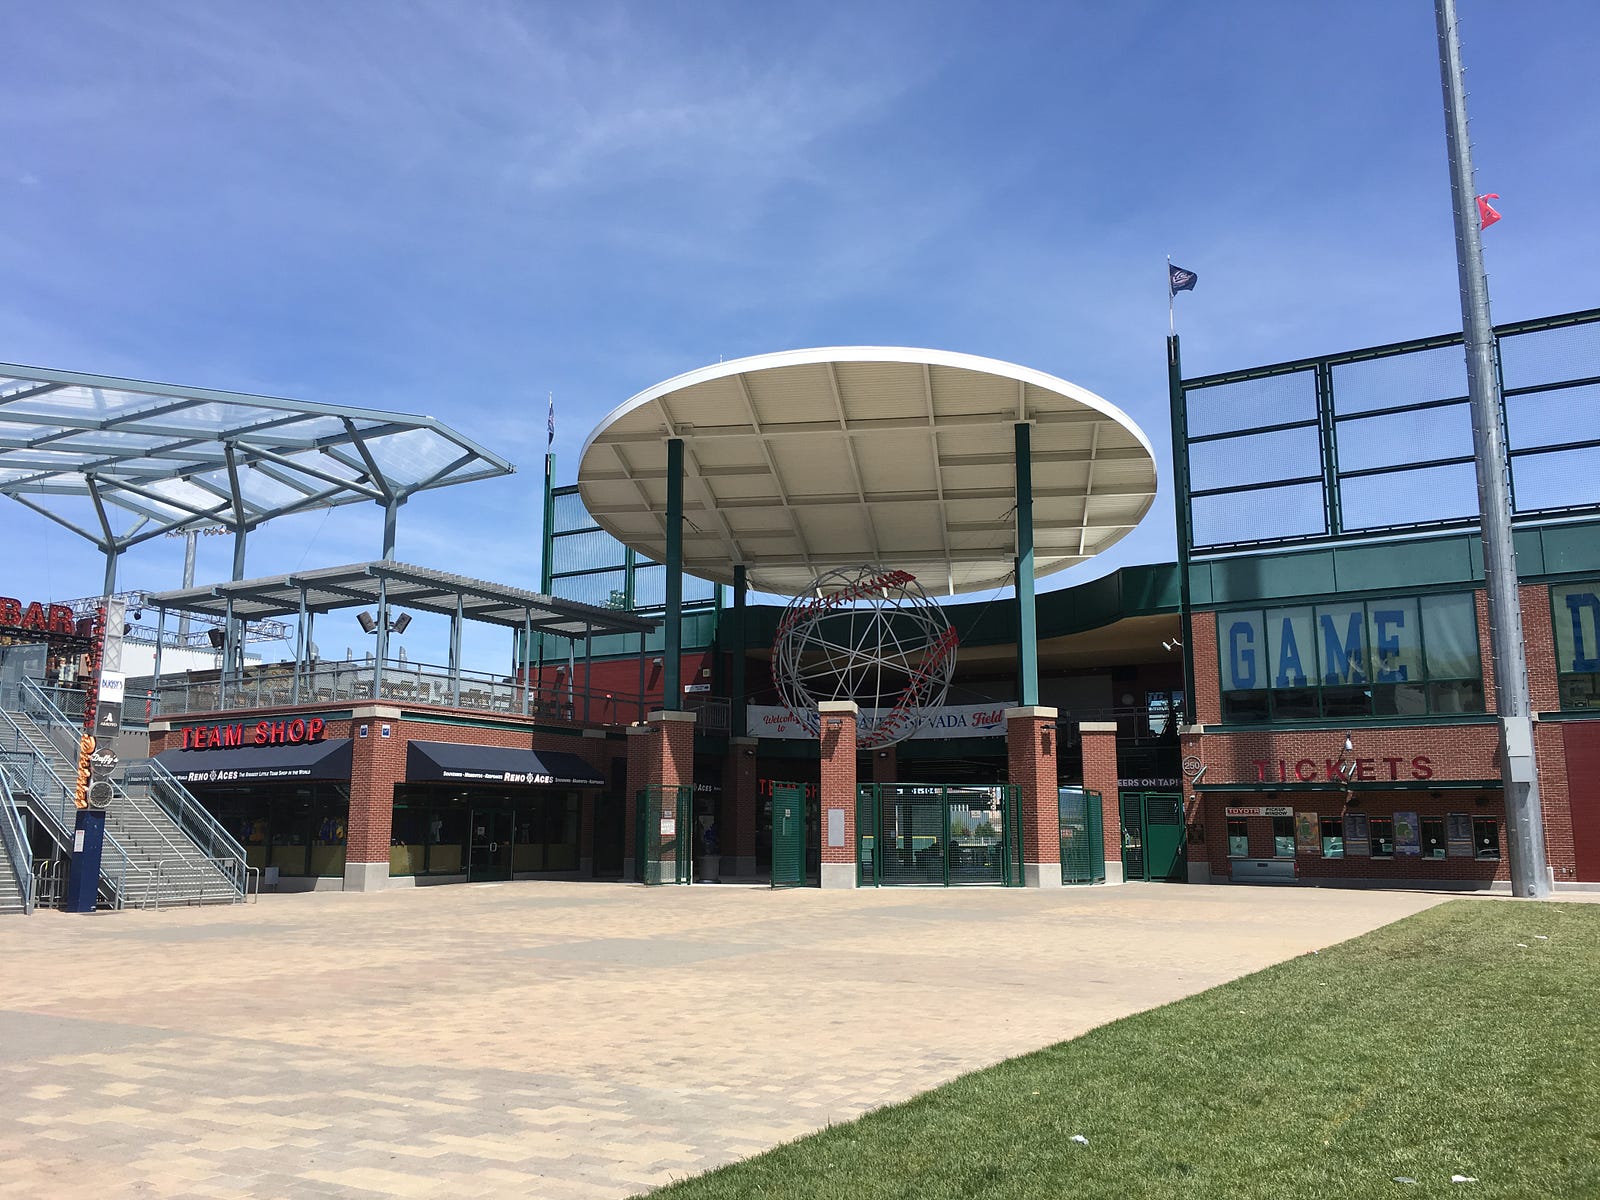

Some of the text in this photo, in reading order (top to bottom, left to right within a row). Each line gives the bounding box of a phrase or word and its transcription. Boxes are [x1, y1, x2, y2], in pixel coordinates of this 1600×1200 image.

[0, 597, 73, 634] BAR
[1229, 610, 1408, 690] GAME
[904, 714, 968, 729] NEVADA
[971, 709, 1004, 727] Field
[181, 717, 325, 750] TEAM SHOP
[777, 724, 786, 732] to
[91, 753, 119, 765] Duffy's
[1183, 761, 1201, 770] 250
[1252, 755, 1434, 782] TICKETS
[188, 771, 209, 782] RENO
[217, 770, 238, 781] ACES
[504, 771, 526, 783] RENO
[534, 773, 554, 784] ACES
[1118, 778, 1179, 787] EERS ON TAP!
[1228, 807, 1260, 815] TOYOTA
